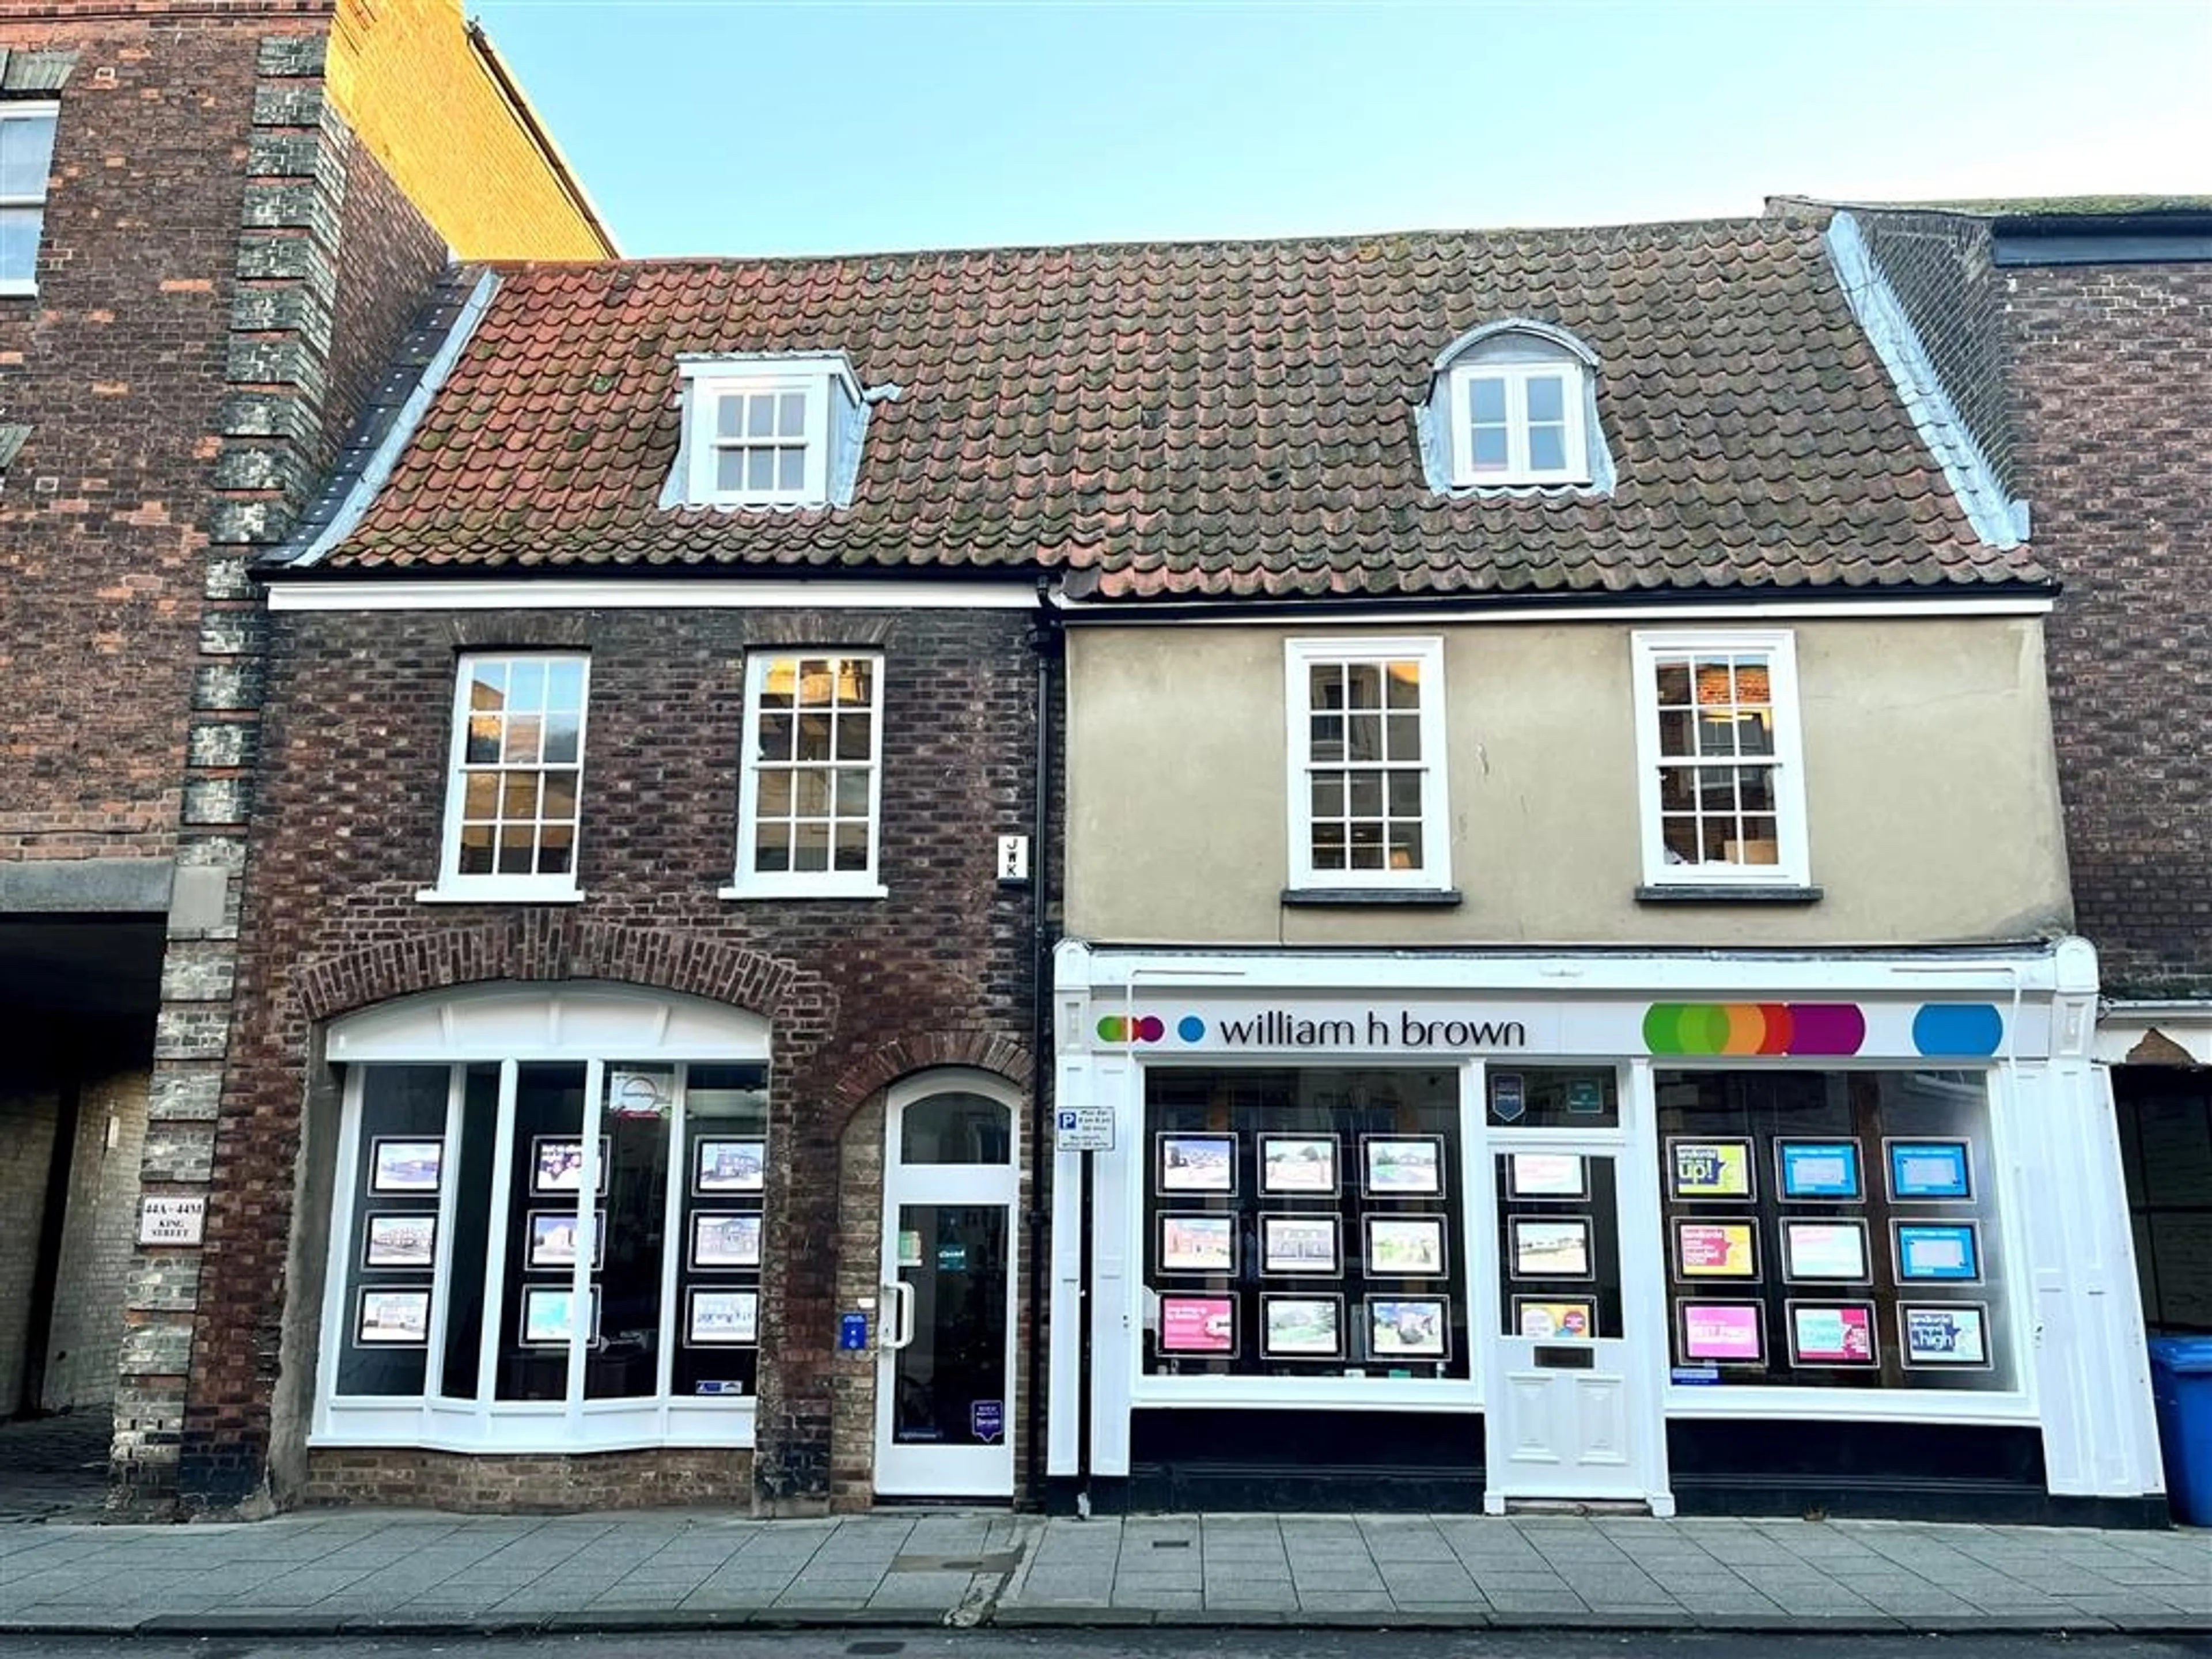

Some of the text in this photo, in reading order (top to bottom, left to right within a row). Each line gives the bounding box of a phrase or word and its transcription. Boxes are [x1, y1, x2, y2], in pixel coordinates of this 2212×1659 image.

[1220, 1011, 1525, 1046] william h brown
